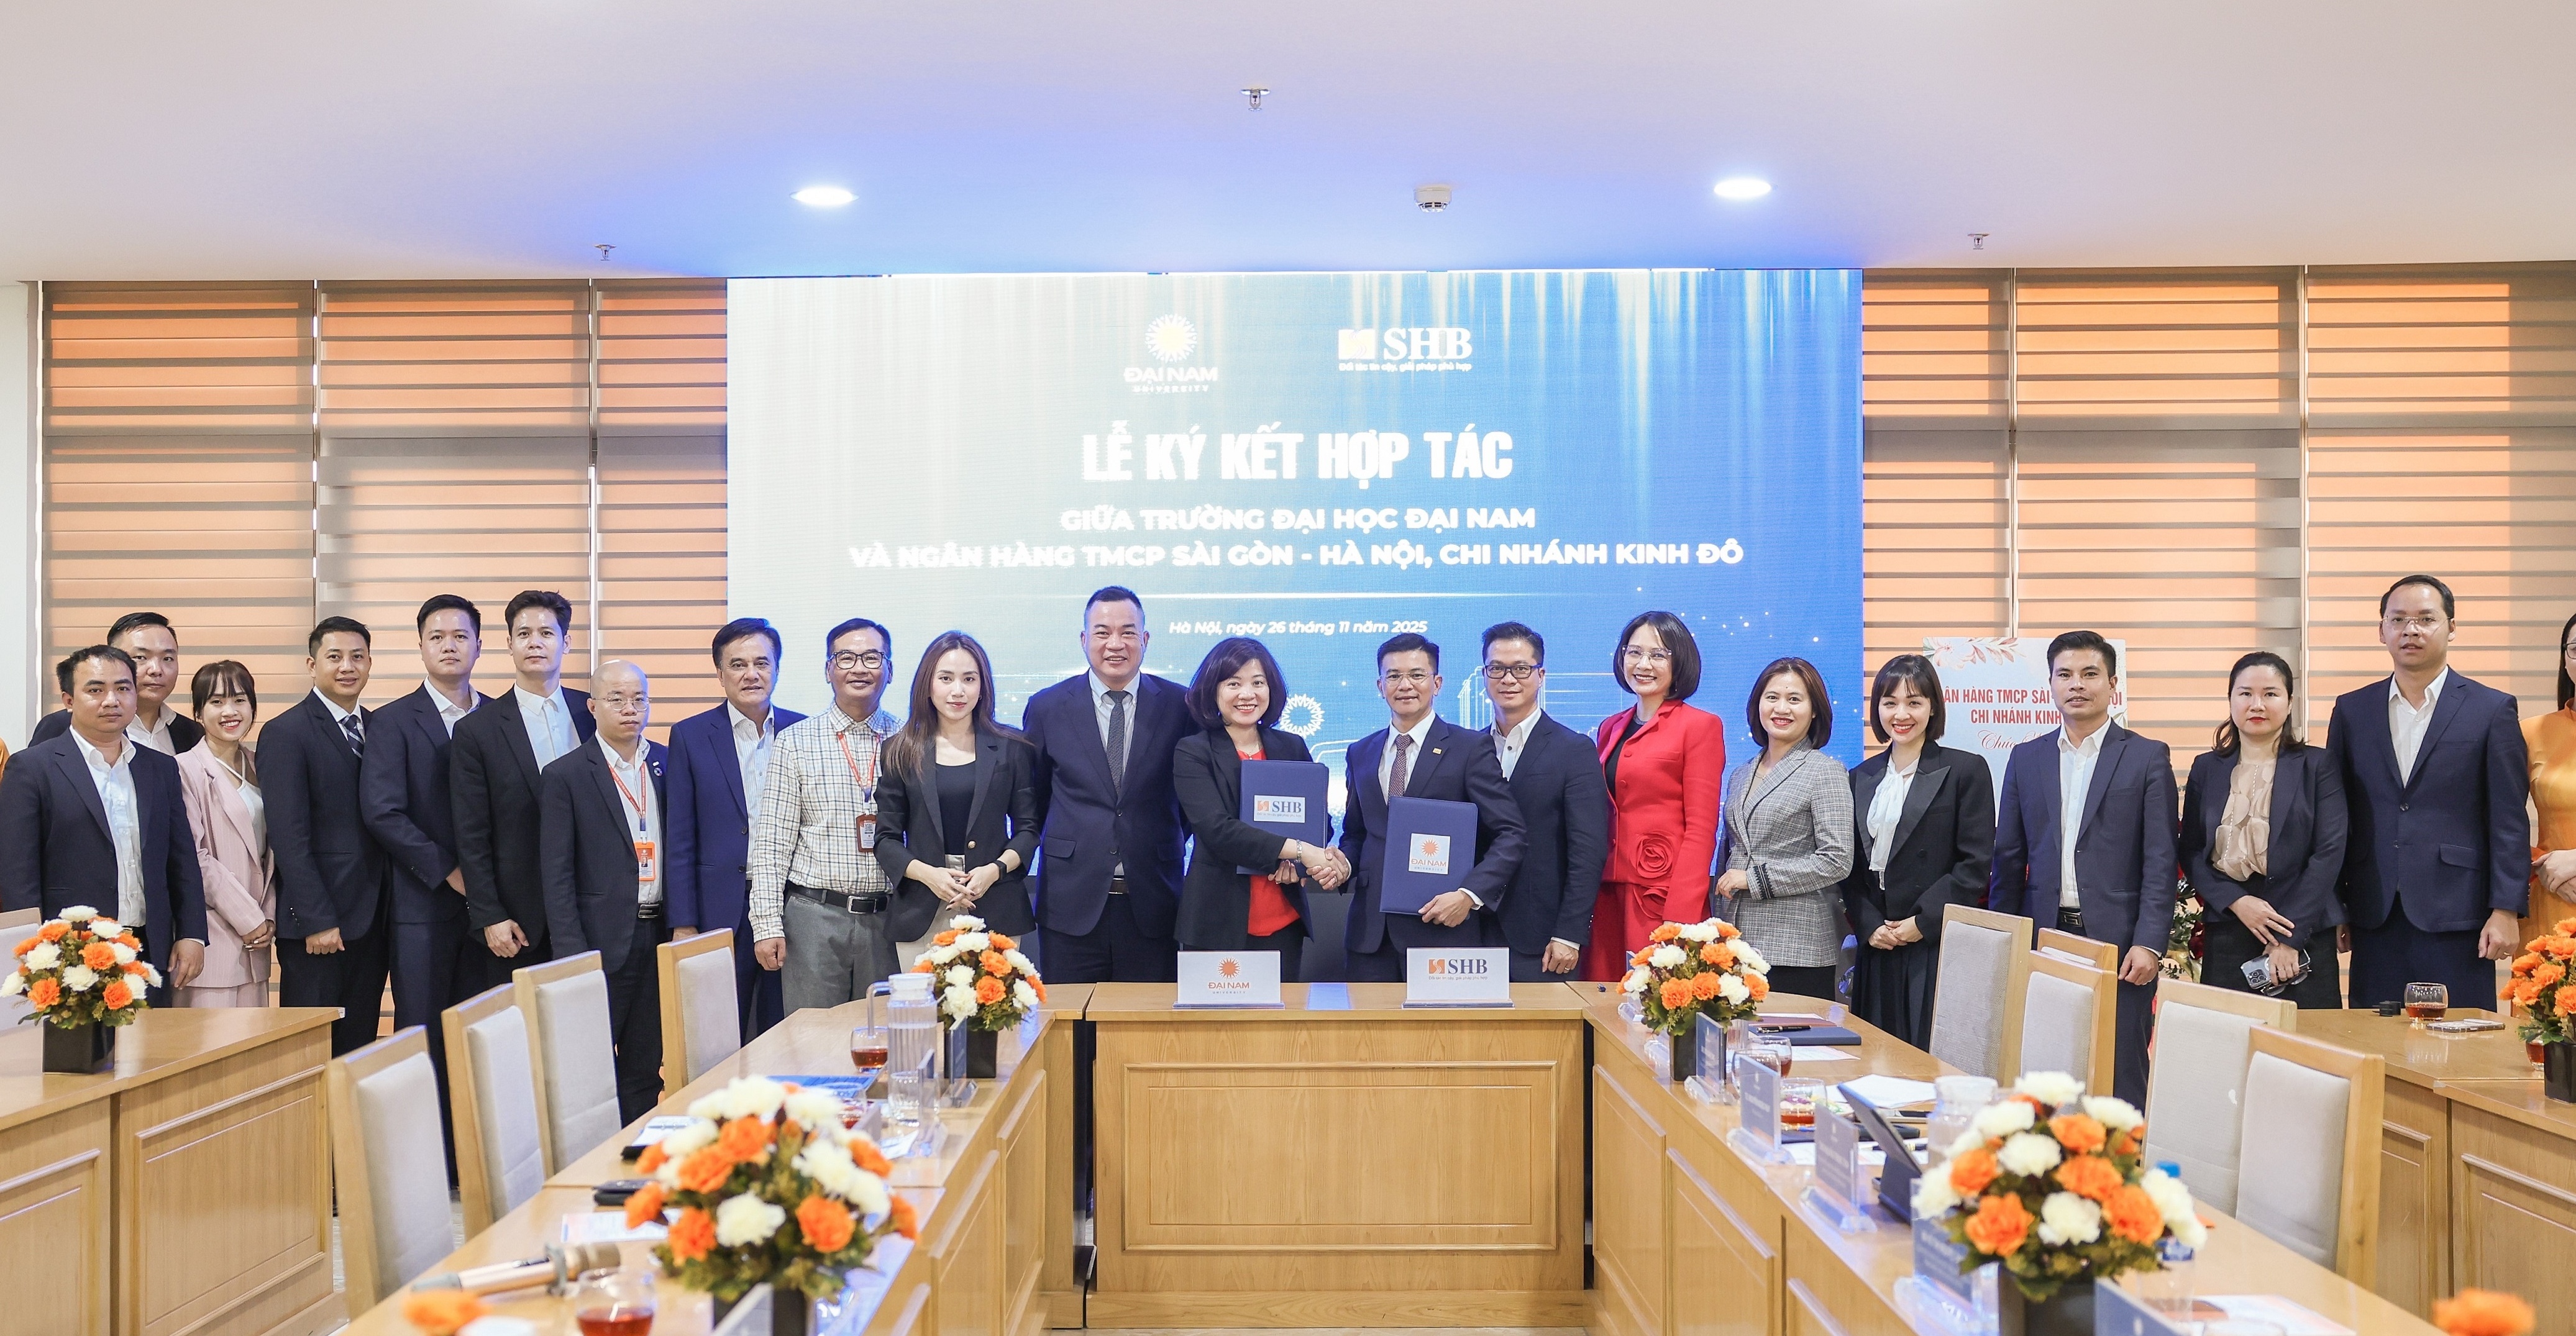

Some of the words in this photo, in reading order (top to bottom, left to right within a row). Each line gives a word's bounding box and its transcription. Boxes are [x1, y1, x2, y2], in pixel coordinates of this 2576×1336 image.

[1383, 327, 1473, 360] SHB
[1123, 367, 1163, 384] ĐẠI
[1167, 366, 1218, 382] NAM
[1132, 384, 1208, 393] UNIVERSITY
[1082, 420, 1133, 481] LỄ
[1146, 423, 1207, 480] KÝ
[1221, 421, 1304, 479] KẾT
[1318, 429, 1409, 489] HỢP
[1423, 423, 1513, 479] TÁC
[1061, 504, 1135, 531] GIỮA
[1140, 504, 1264, 530] TRƯỜNG
[1271, 508, 1325, 534] ĐẠI
[1333, 508, 1398, 534] HỌC
[1404, 507, 1458, 534] ĐẠI
[1467, 507, 1535, 528] NAM
[849, 542, 892, 568] VÀ
[898, 542, 984, 568] NGÂN
[990, 541, 1075, 568] HÀNG
[1082, 545, 1166, 566] TMCP
[1171, 540, 1220, 566] SÀI
[1227, 540, 1293, 565] GÒN
[1320, 540, 1364, 565] HÀ
[1371, 538, 1433, 570] NỘI,
[1440, 543, 1491, 565] CHI
[1499, 538, 1607, 565] NHÁNH
[1616, 543, 1689, 564] KINH
[1696, 538, 1744, 564] ĐÔ
[1169, 622, 1190, 634] Hà
[1194, 621, 1223, 636] Nội,
[1226, 621, 1266, 636] ngày
[1267, 621, 1286, 634] 26
[1289, 621, 1335, 636] tháng
[1338, 620, 1351, 633] 11
[1353, 620, 1389, 634] năm
[1391, 620, 1428, 634] 2025
[1963, 688, 1993, 704] HÀNG
[1997, 689, 2027, 704] TMCP
[2032, 688, 2050, 704] SÀI
[1971, 709, 1989, 724] CHI
[1993, 706, 2031, 724] NHÁNH
[2035, 710, 2062, 725] KINH
[1272, 801, 1302, 813] SHB
[1448, 958, 1487, 975] SHB
[1208, 982, 1225, 990] ĐẠI
